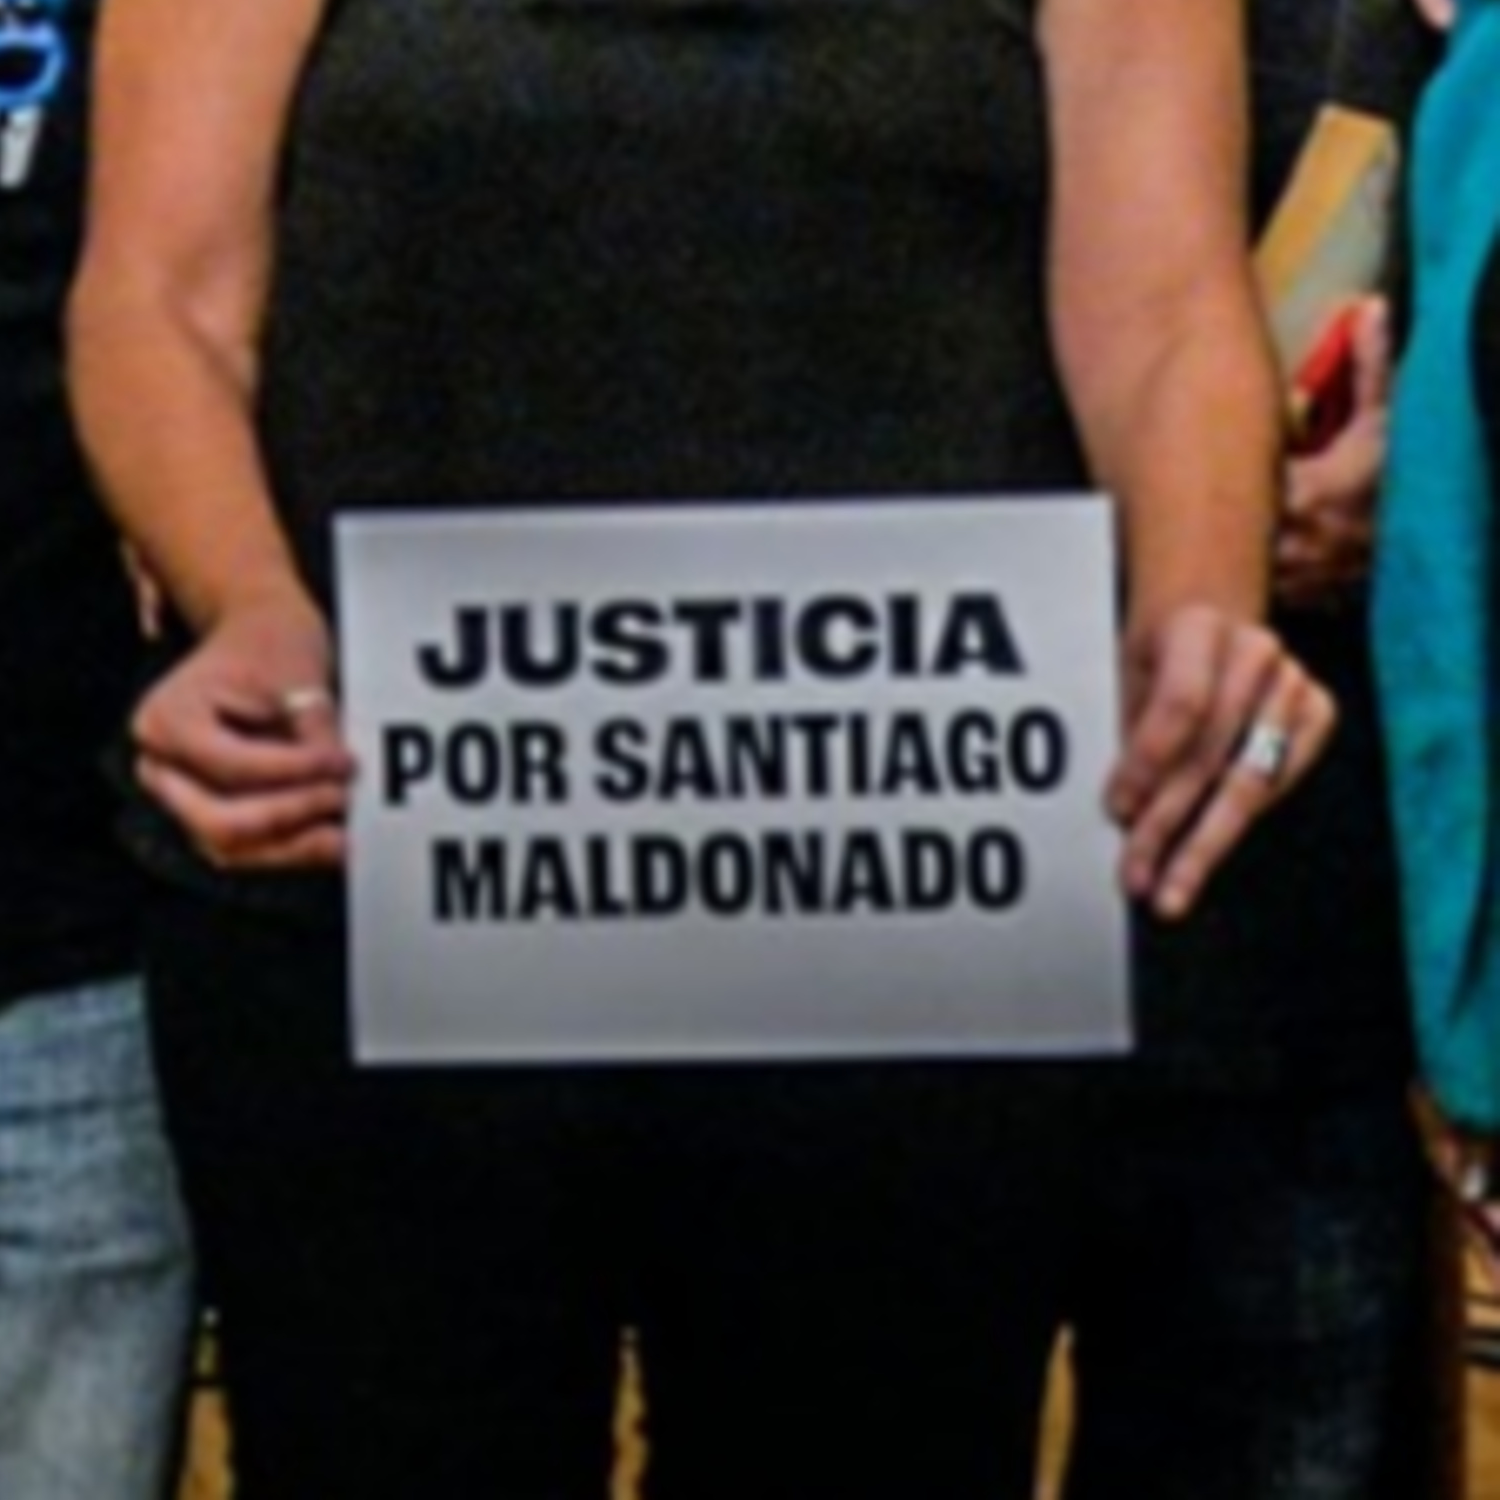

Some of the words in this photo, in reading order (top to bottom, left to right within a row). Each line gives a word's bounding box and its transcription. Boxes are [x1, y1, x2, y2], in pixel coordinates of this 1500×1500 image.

[415, 591, 1025, 692] JUSTICIA
[380, 718, 571, 809] POR
[591, 705, 1069, 805] SANTIAGO
[429, 824, 1028, 925] MALDONADO
